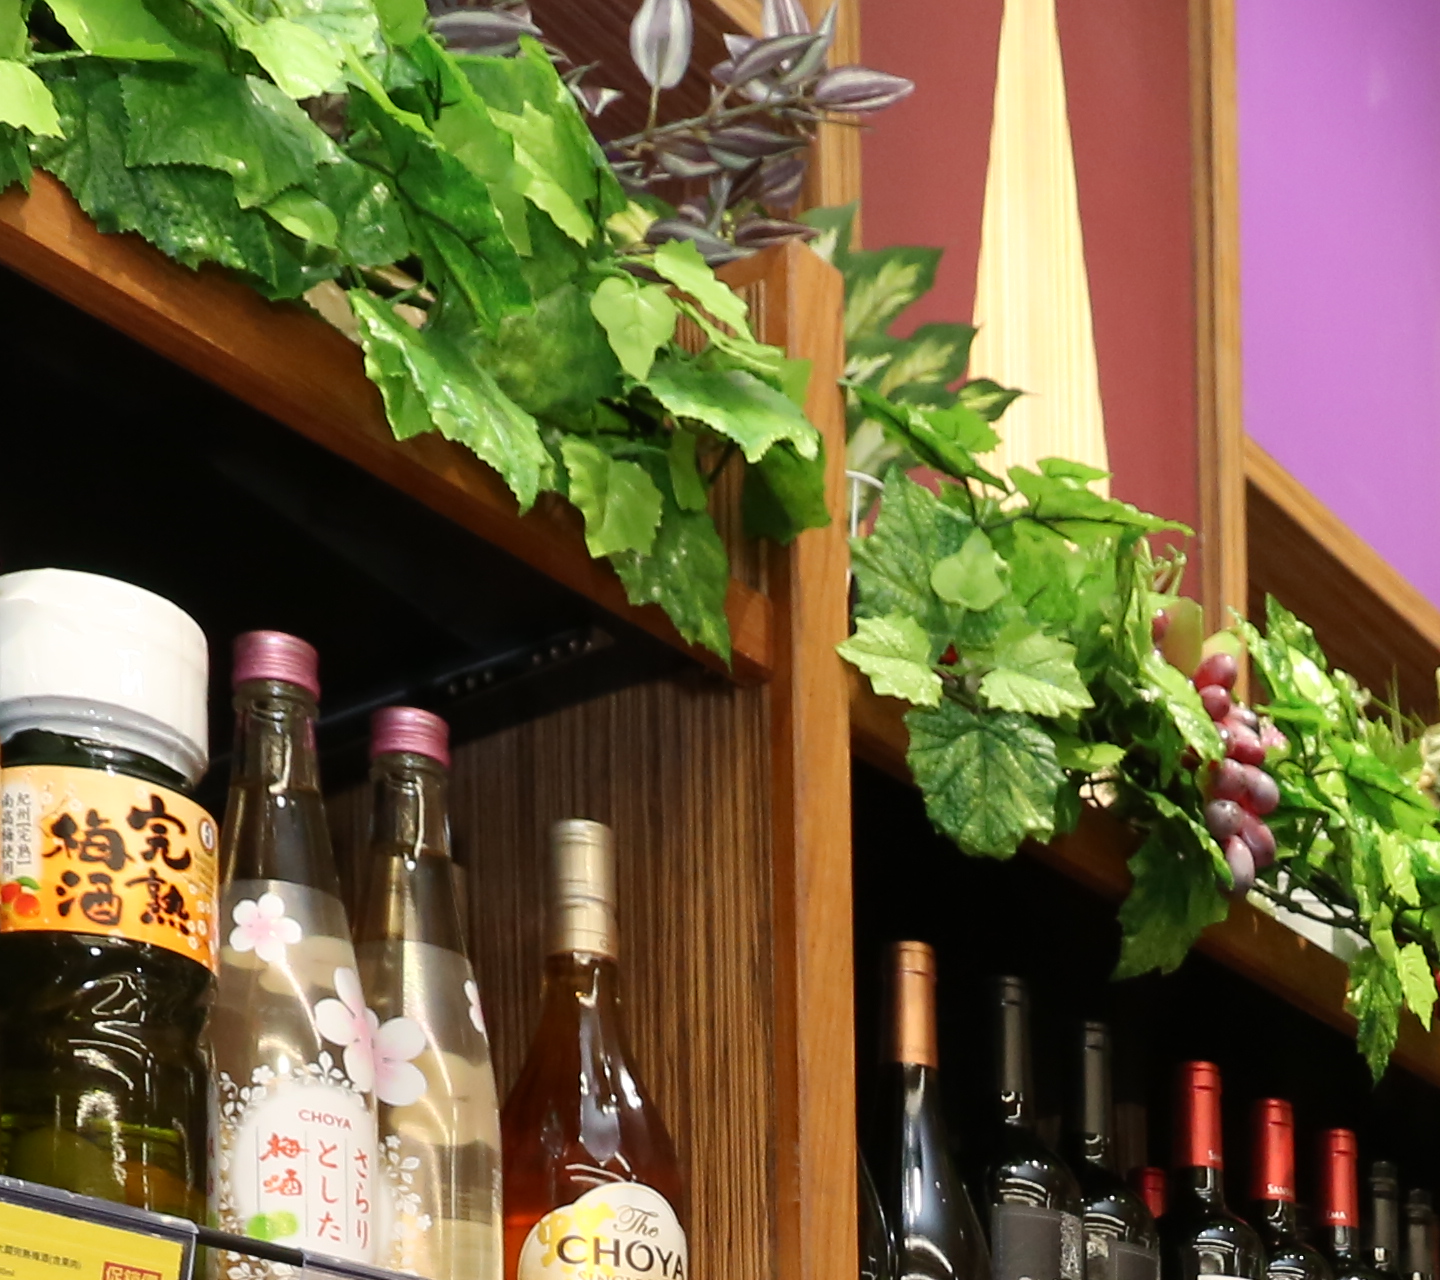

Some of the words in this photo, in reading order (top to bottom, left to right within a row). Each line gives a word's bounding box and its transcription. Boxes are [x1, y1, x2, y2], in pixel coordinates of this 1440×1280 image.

[43, 811, 133, 926] 梅酒
[126, 794, 191, 936] 完熟
[259, 1132, 305, 1198] 梅酒
[297, 1107, 353, 1131] CHOYA
[315, 1138, 342, 1242] とした
[352, 1147, 372, 1251] さらり
[613, 1204, 660, 1238] The
